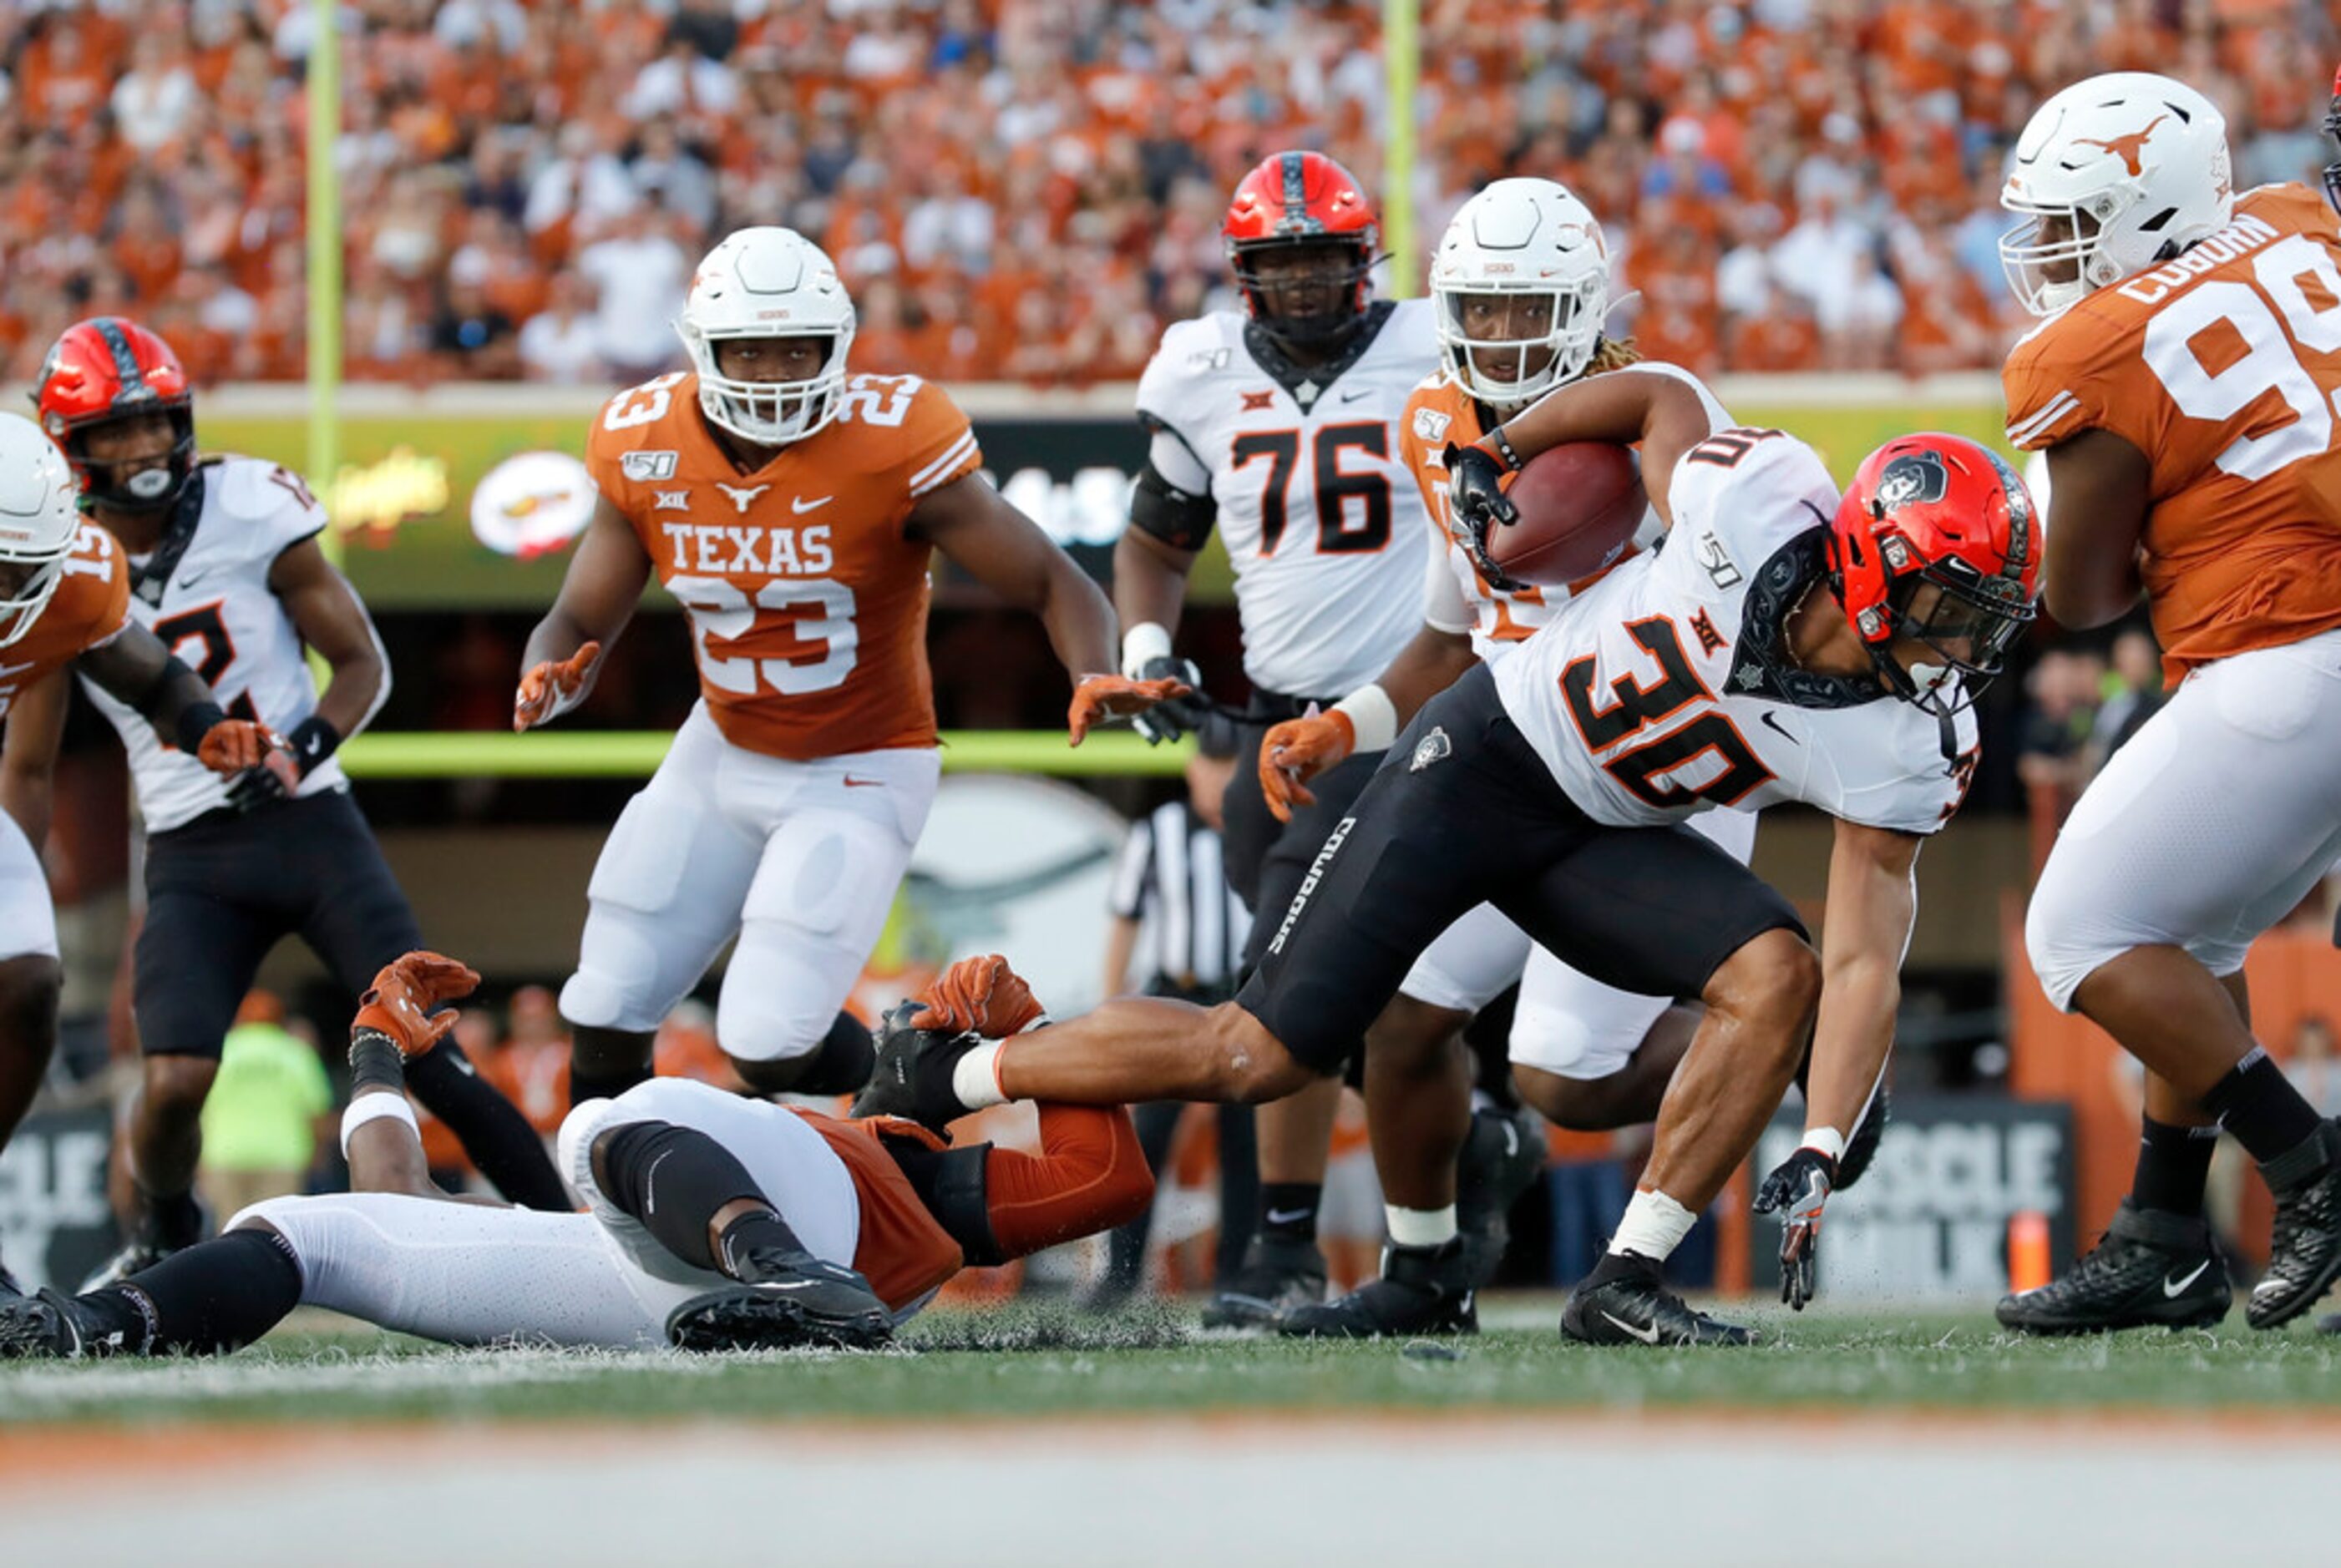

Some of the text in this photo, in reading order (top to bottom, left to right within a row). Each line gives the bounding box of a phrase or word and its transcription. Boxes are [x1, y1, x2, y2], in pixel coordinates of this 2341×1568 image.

[662, 523, 834, 574] TEXAS
[1231, 420, 1394, 559] 76
[665, 576, 859, 695] 23
[1558, 613, 1779, 809] 30
[1268, 817, 1357, 954] COWBOYS
